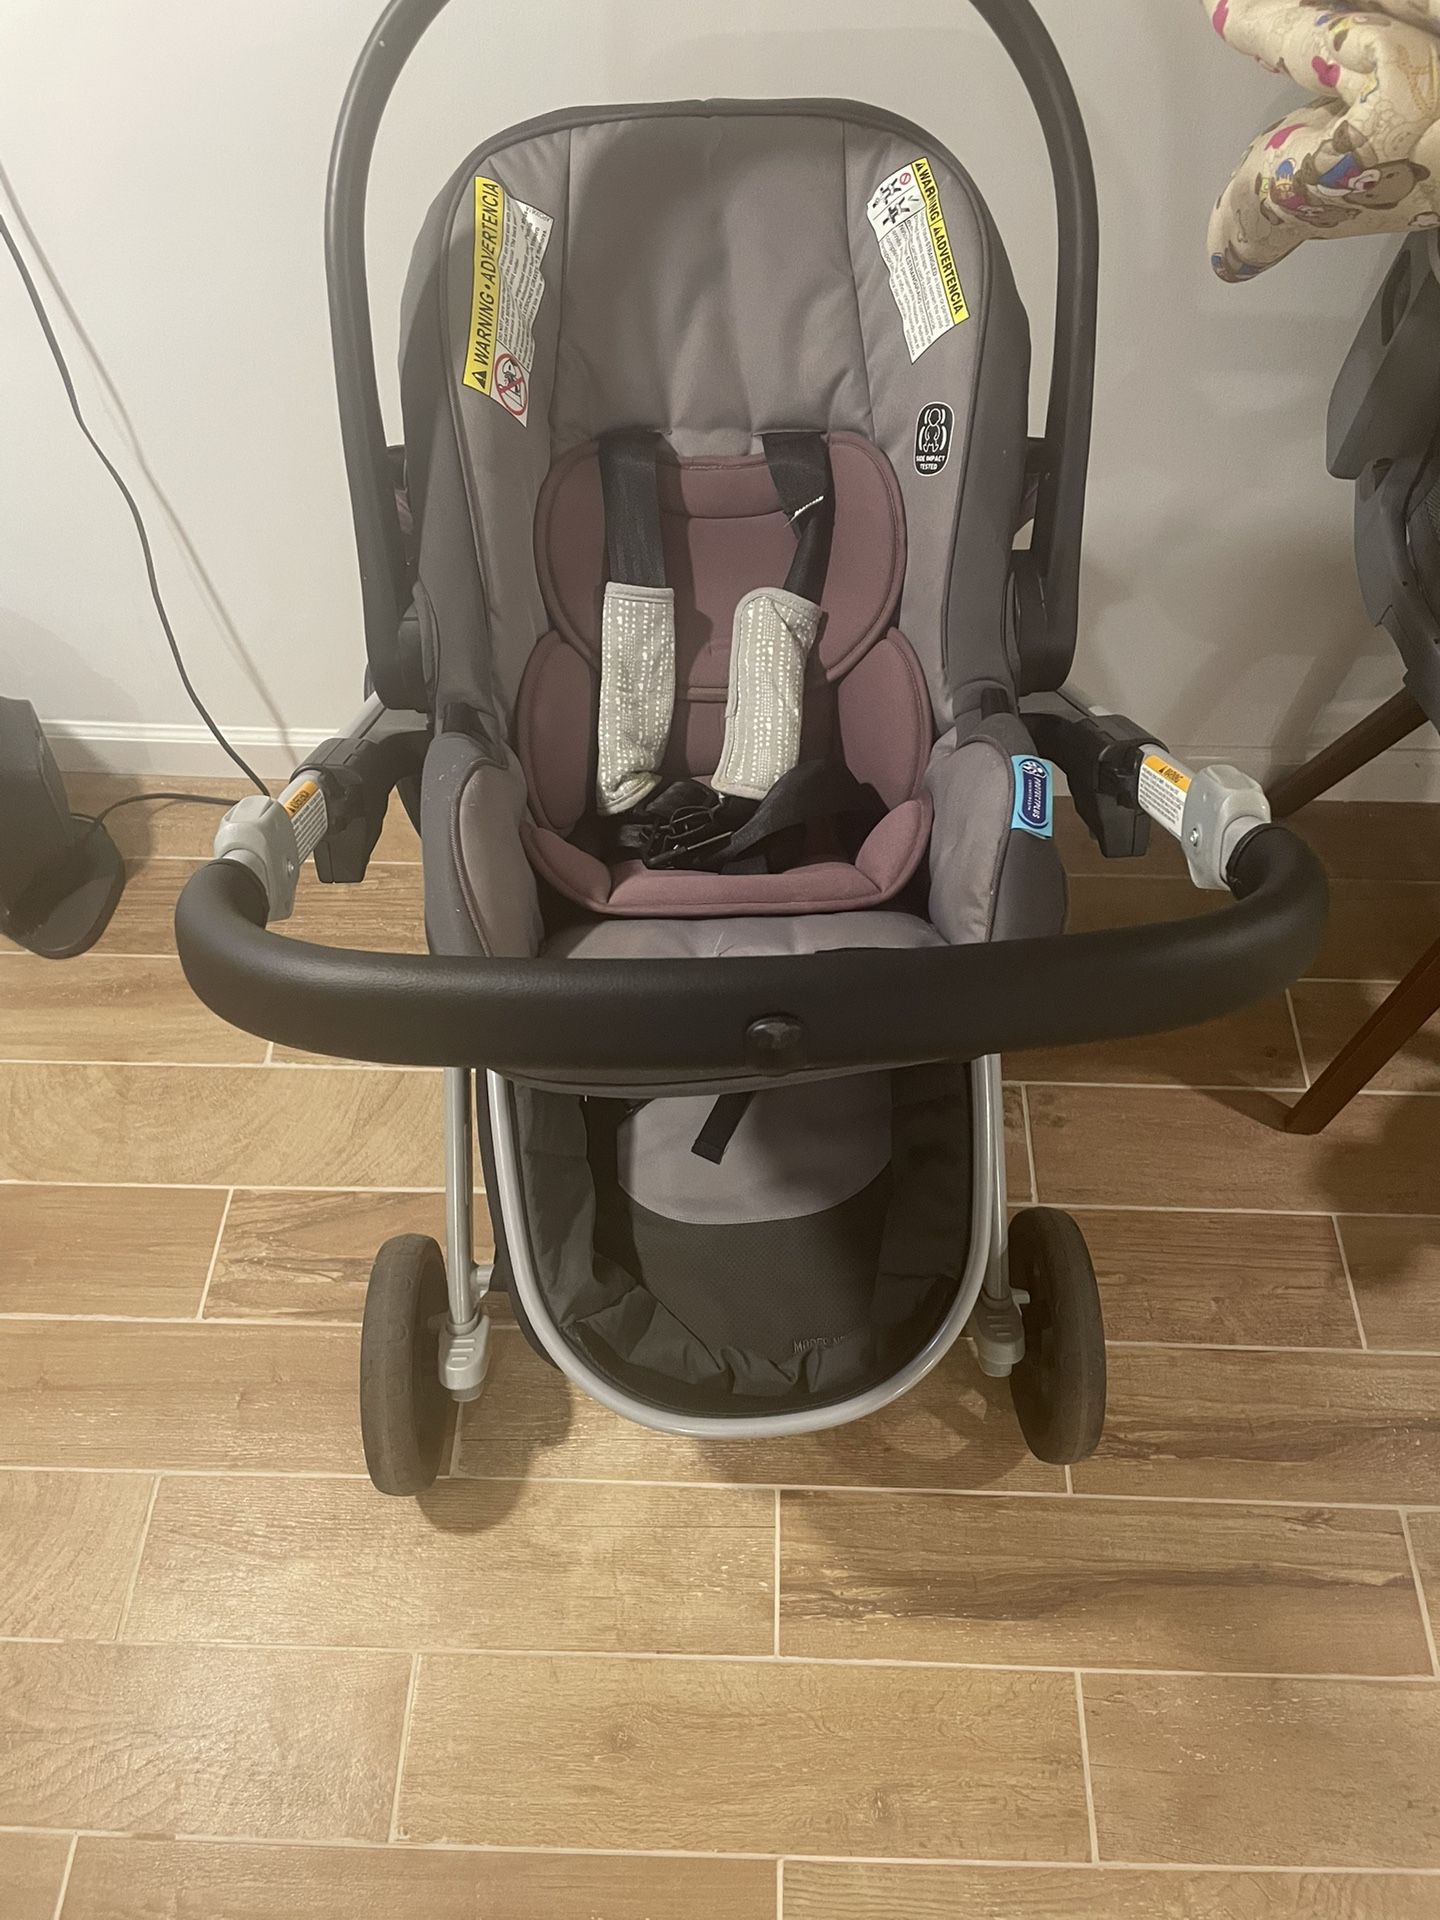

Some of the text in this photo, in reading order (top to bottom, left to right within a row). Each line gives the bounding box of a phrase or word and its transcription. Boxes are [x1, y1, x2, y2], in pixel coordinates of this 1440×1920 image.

[473, 183, 499, 366] WARNING ADVERTENCIA
[919, 168, 963, 315] WARNING ADVERTENCIA
[1032, 777, 1040, 818] PROTECTPLUS
